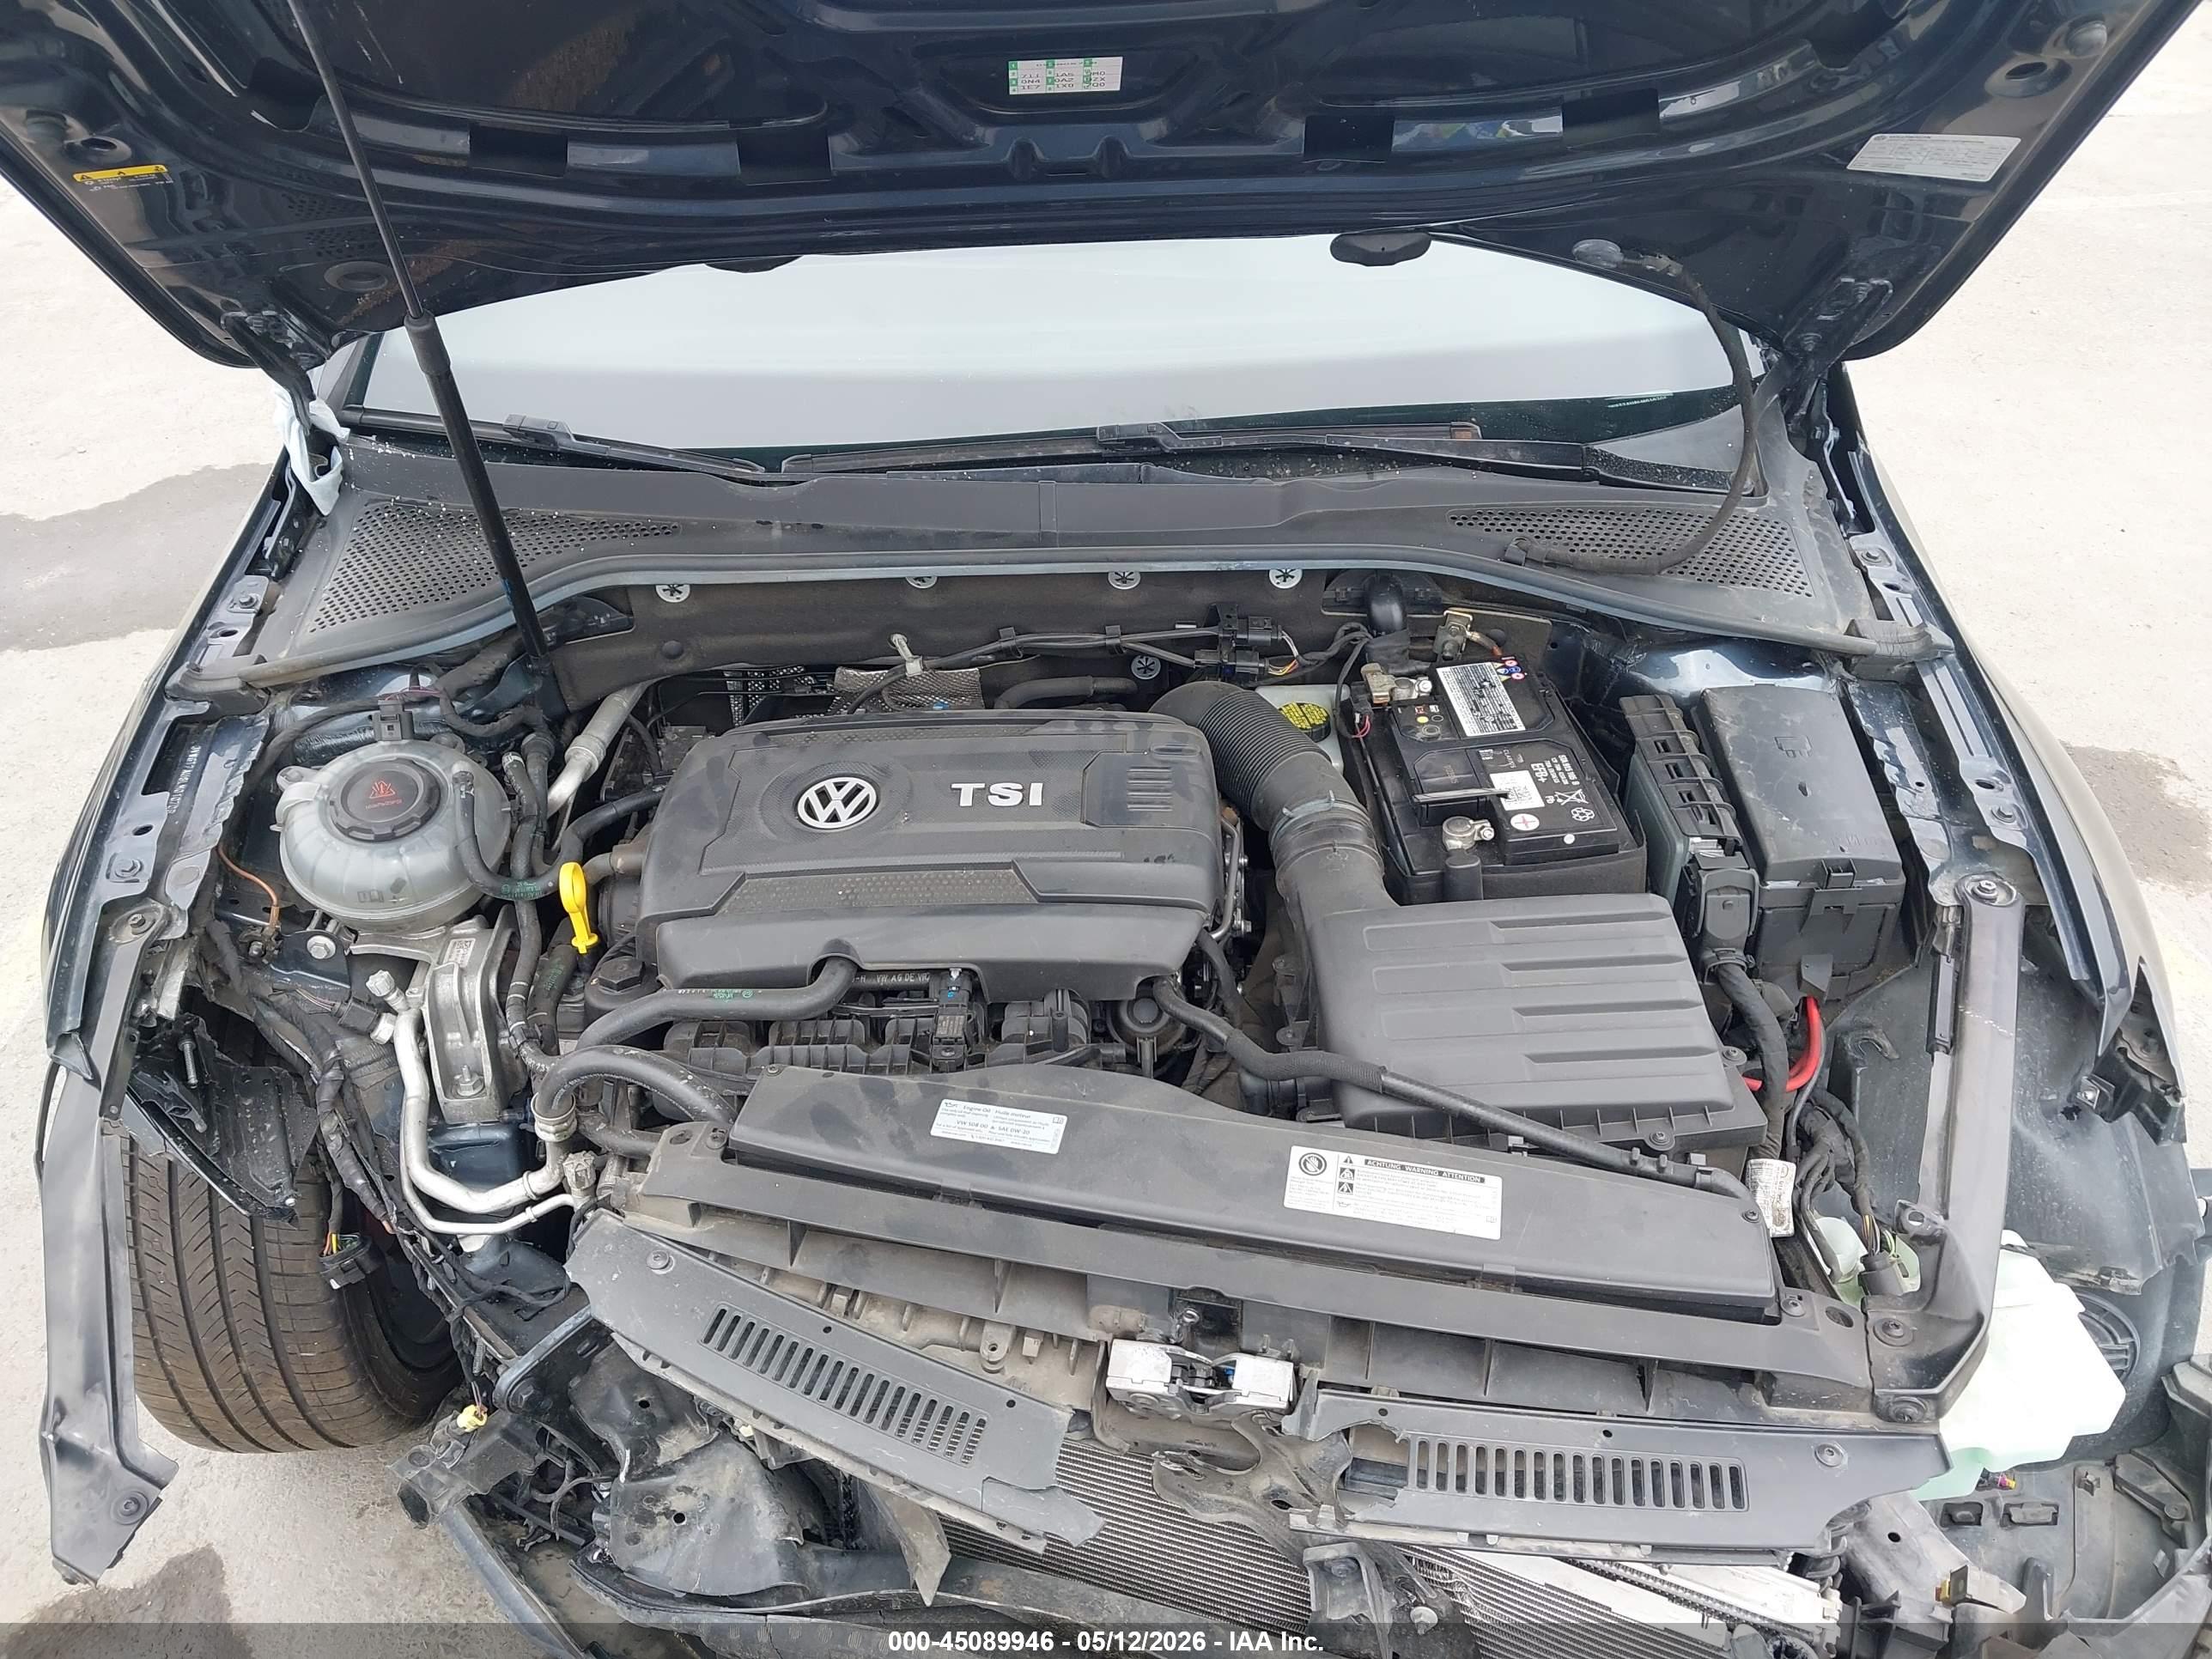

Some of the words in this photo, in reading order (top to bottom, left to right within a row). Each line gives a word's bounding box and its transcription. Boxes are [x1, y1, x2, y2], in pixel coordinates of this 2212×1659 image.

[1530, 763, 1549, 783] EFB+
[951, 782, 1044, 807] TSI
[1367, 1159, 1401, 1170] ACHTUNG
[1404, 1165, 1439, 1176] WARNING
[1442, 1172, 1481, 1182] ATTENTION
